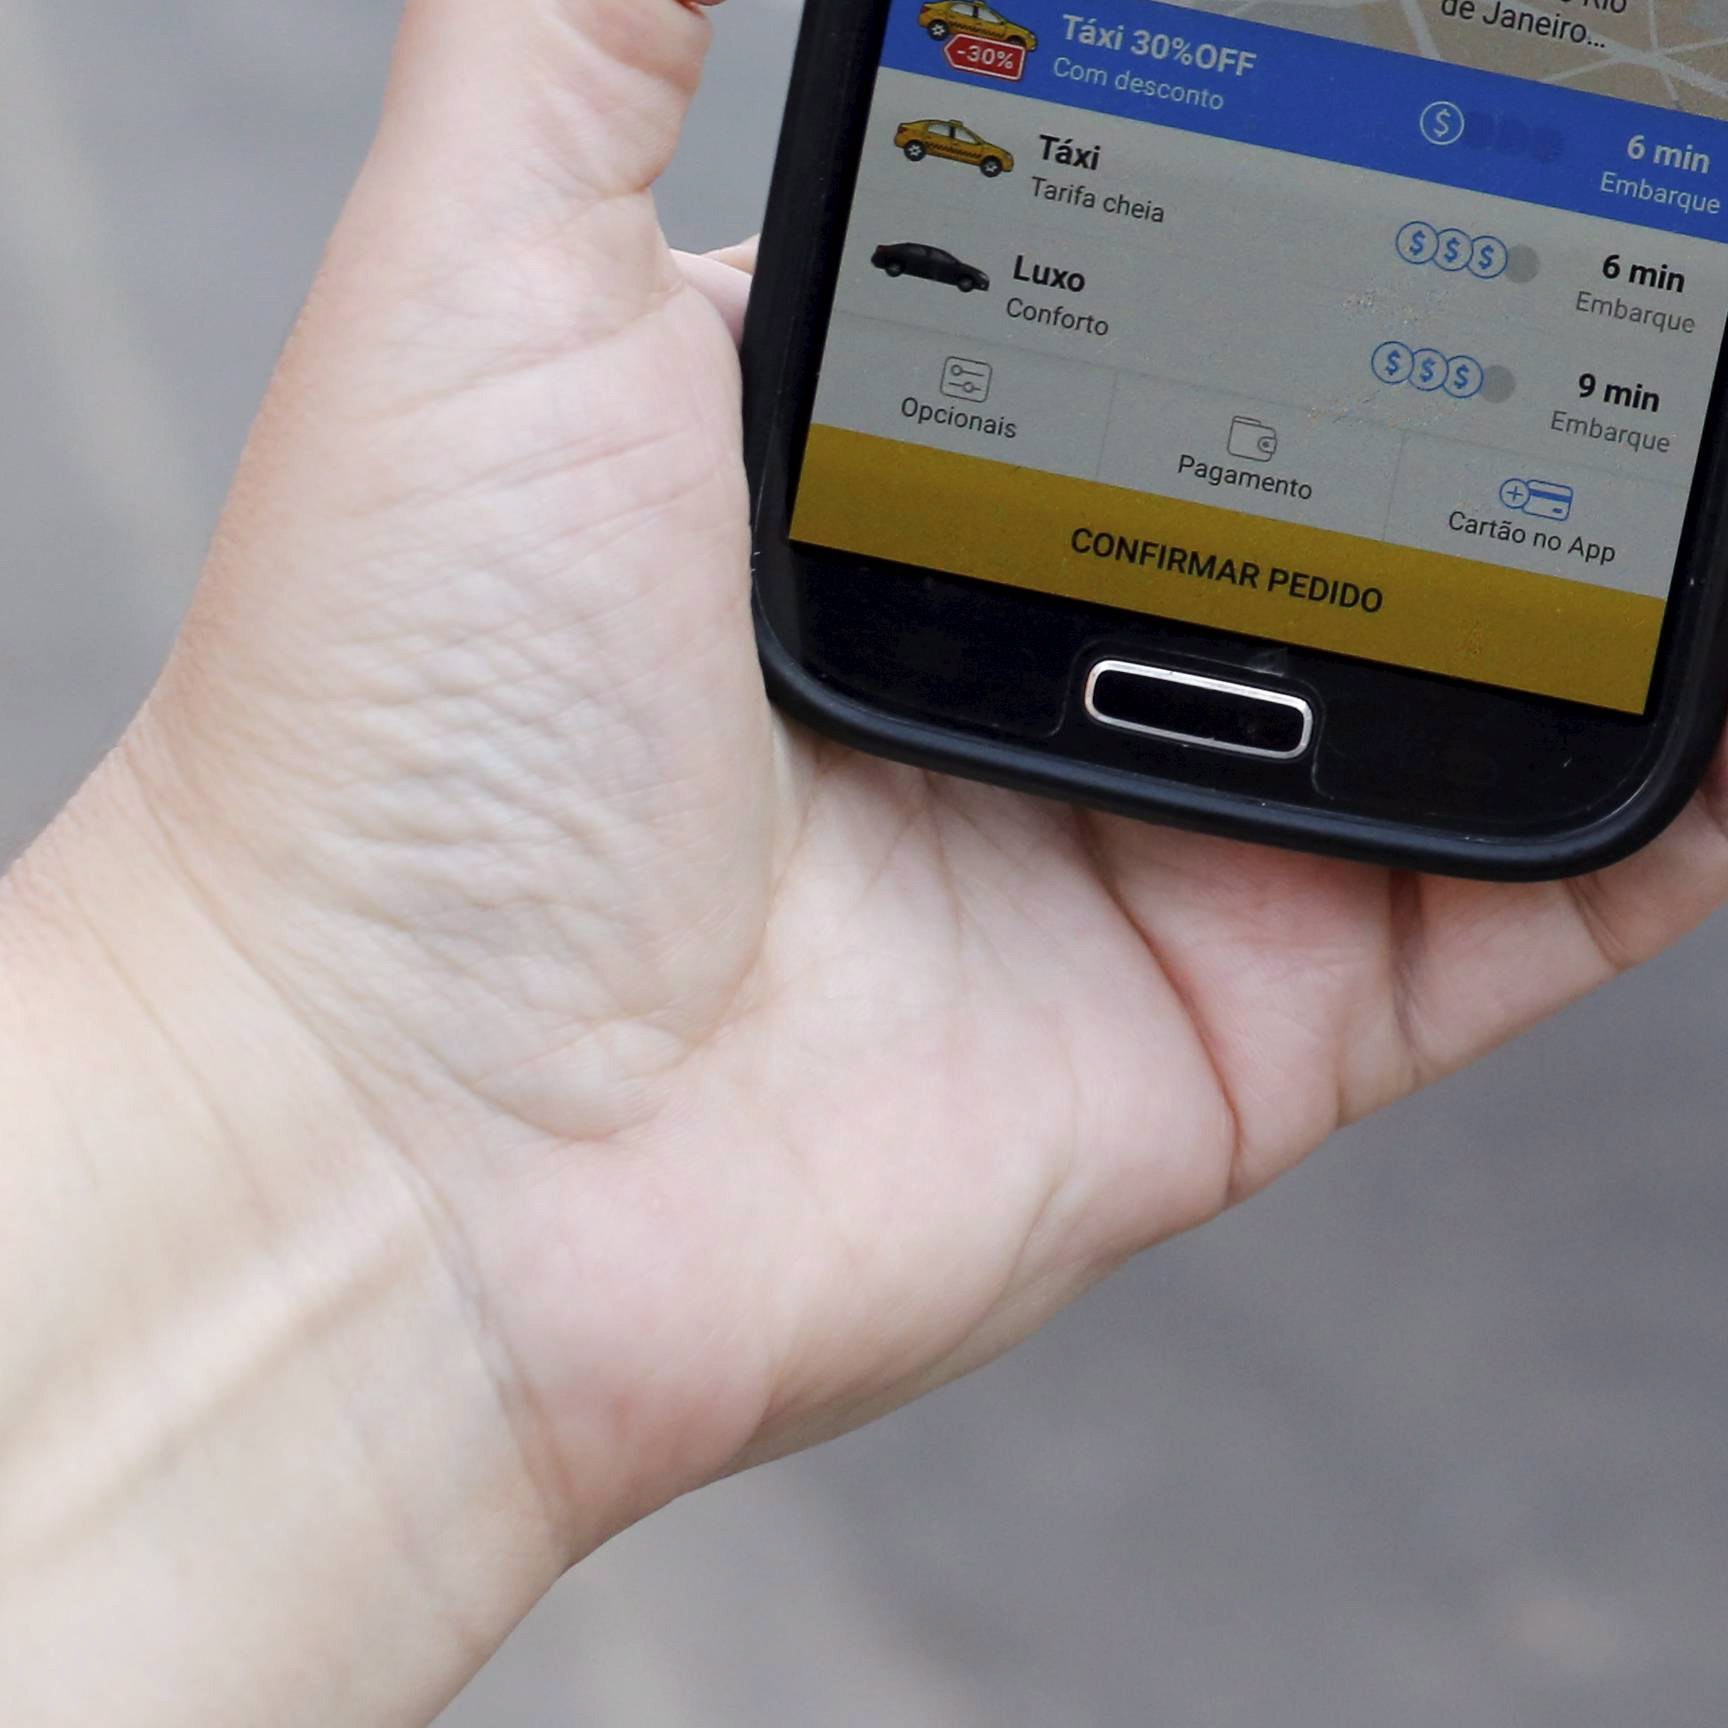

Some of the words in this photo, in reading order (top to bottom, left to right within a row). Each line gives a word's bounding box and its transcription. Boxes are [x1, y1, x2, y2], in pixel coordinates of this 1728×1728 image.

[1062, 13, 1124, 51] Táxi
[1131, 29, 1257, 76] 30%OFF
[1482, 1, 1605, 48] Janeiro...
[956, 45, 1014, 70] -30%
[1053, 57, 1107, 86] Com
[1114, 71, 1224, 110] desconto
[1039, 134, 1102, 170] Táxi
[1627, 134, 1645, 160] 6
[1653, 144, 1711, 174] min
[1031, 177, 1096, 209] Tarifa
[1103, 193, 1165, 223] cheia
[1600, 171, 1721, 214] Embarque
[1012, 255, 1086, 292] Luxo
[1602, 254, 1620, 279] 6
[1628, 263, 1686, 293] min
[1006, 297, 1109, 336] Conforto
[1575, 291, 1696, 333] Embarque
[1578, 372, 1596, 398] 9
[1603, 382, 1661, 413] min
[901, 397, 1017, 439] Opcionais
[1551, 410, 1671, 453] Embarque
[1177, 454, 1313, 500] Pagamento
[1449, 510, 1526, 543] Cartão
[1533, 532, 1562, 551] no
[1568, 536, 1616, 565] App
[1071, 527, 1260, 589] CONFIRMAR
[1267, 567, 1384, 613] PEDIDO
